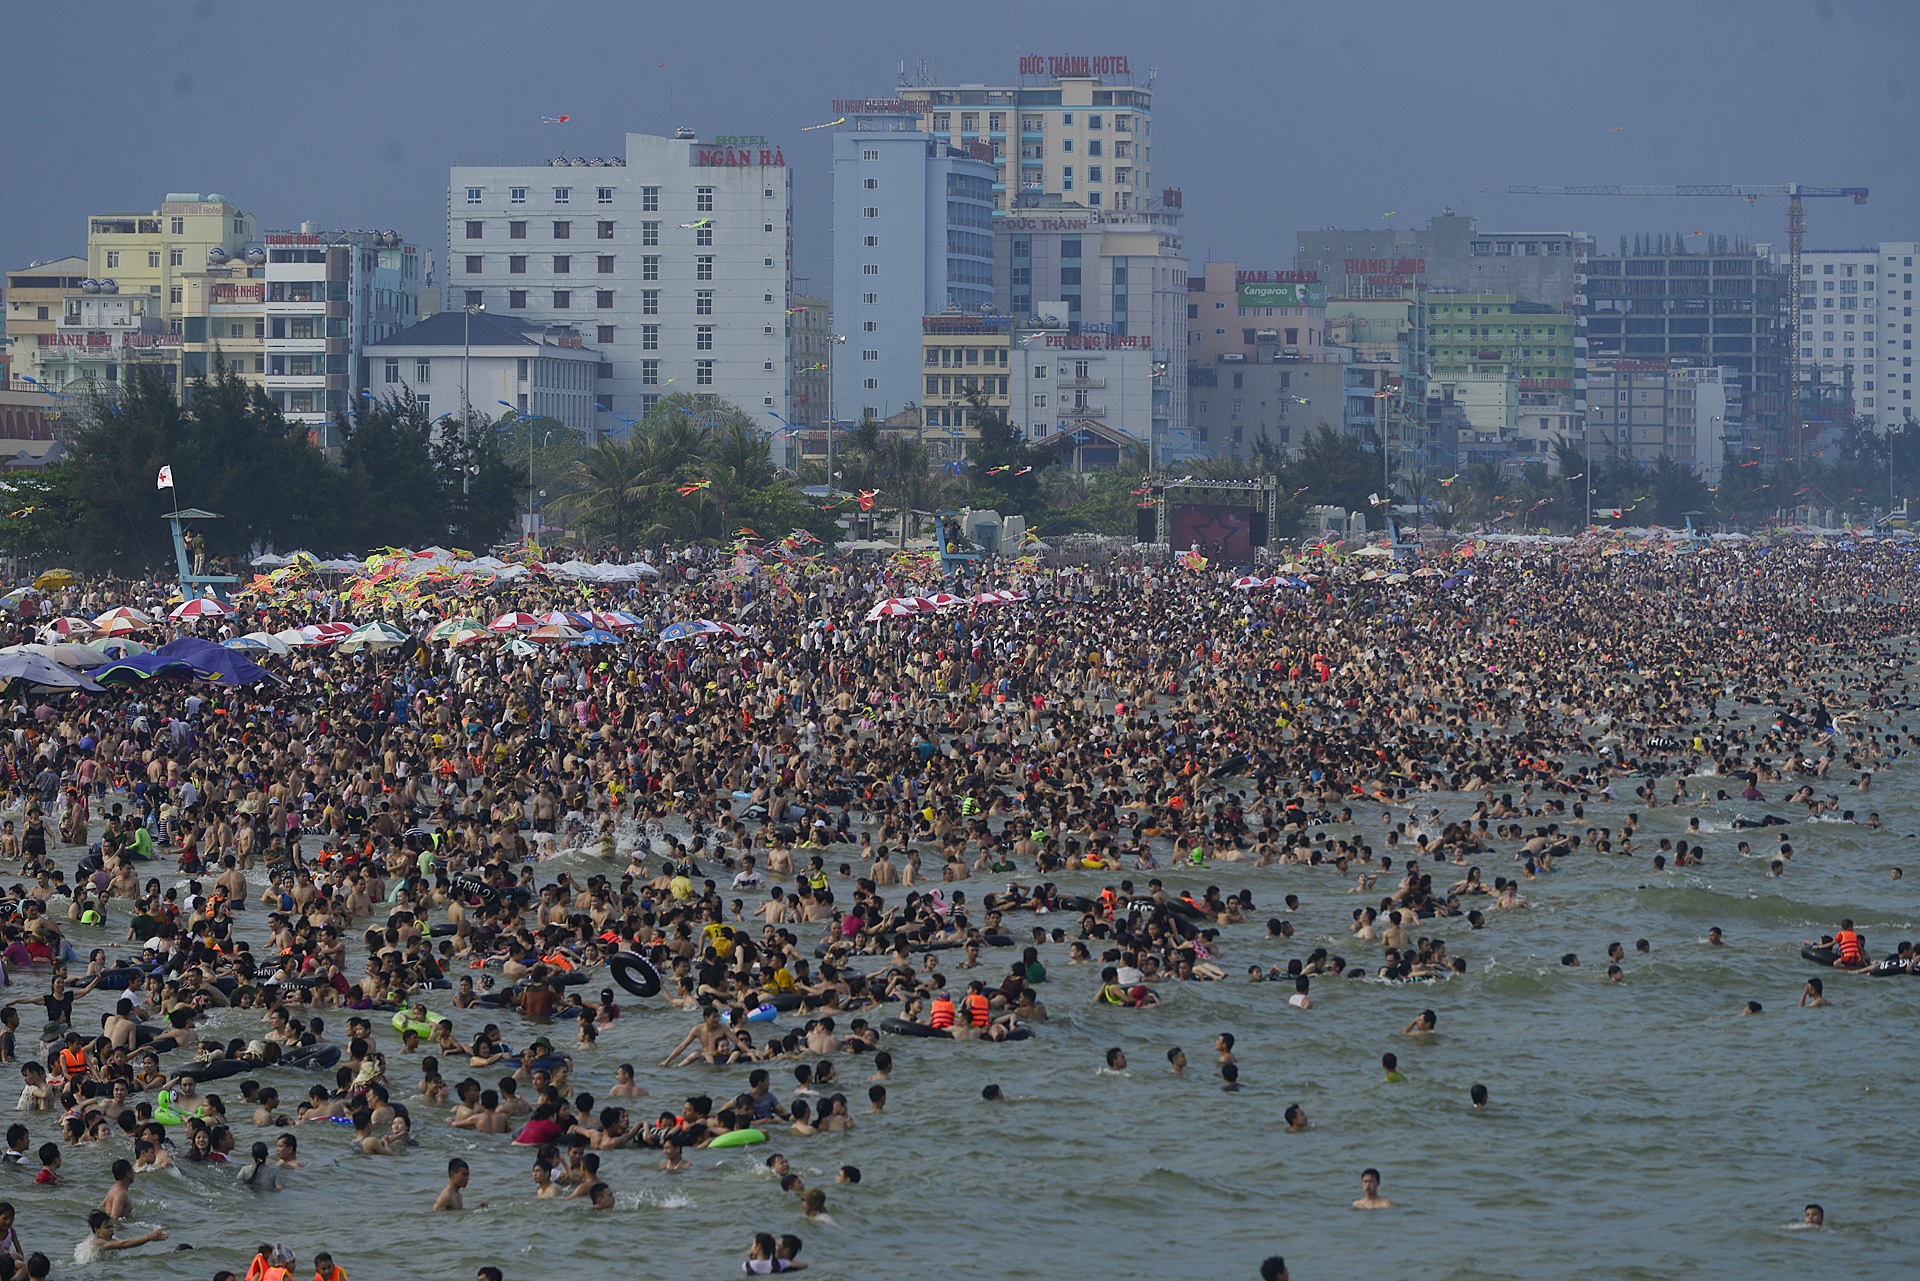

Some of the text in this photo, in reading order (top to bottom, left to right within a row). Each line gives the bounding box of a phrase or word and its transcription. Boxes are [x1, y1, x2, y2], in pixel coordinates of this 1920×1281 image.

[1020, 53, 1130, 75] ĐỨC THÀNH HOTEL
[715, 135, 768, 145] HOTEL
[699, 145, 786, 166] NGÂN HÀ
[1006, 216, 1087, 230] ĐỨC THÀNH
[1241, 286, 1288, 297] Kangaroo
[1079, 321, 1118, 332] Hotel
[42, 334, 83, 346] THANH
